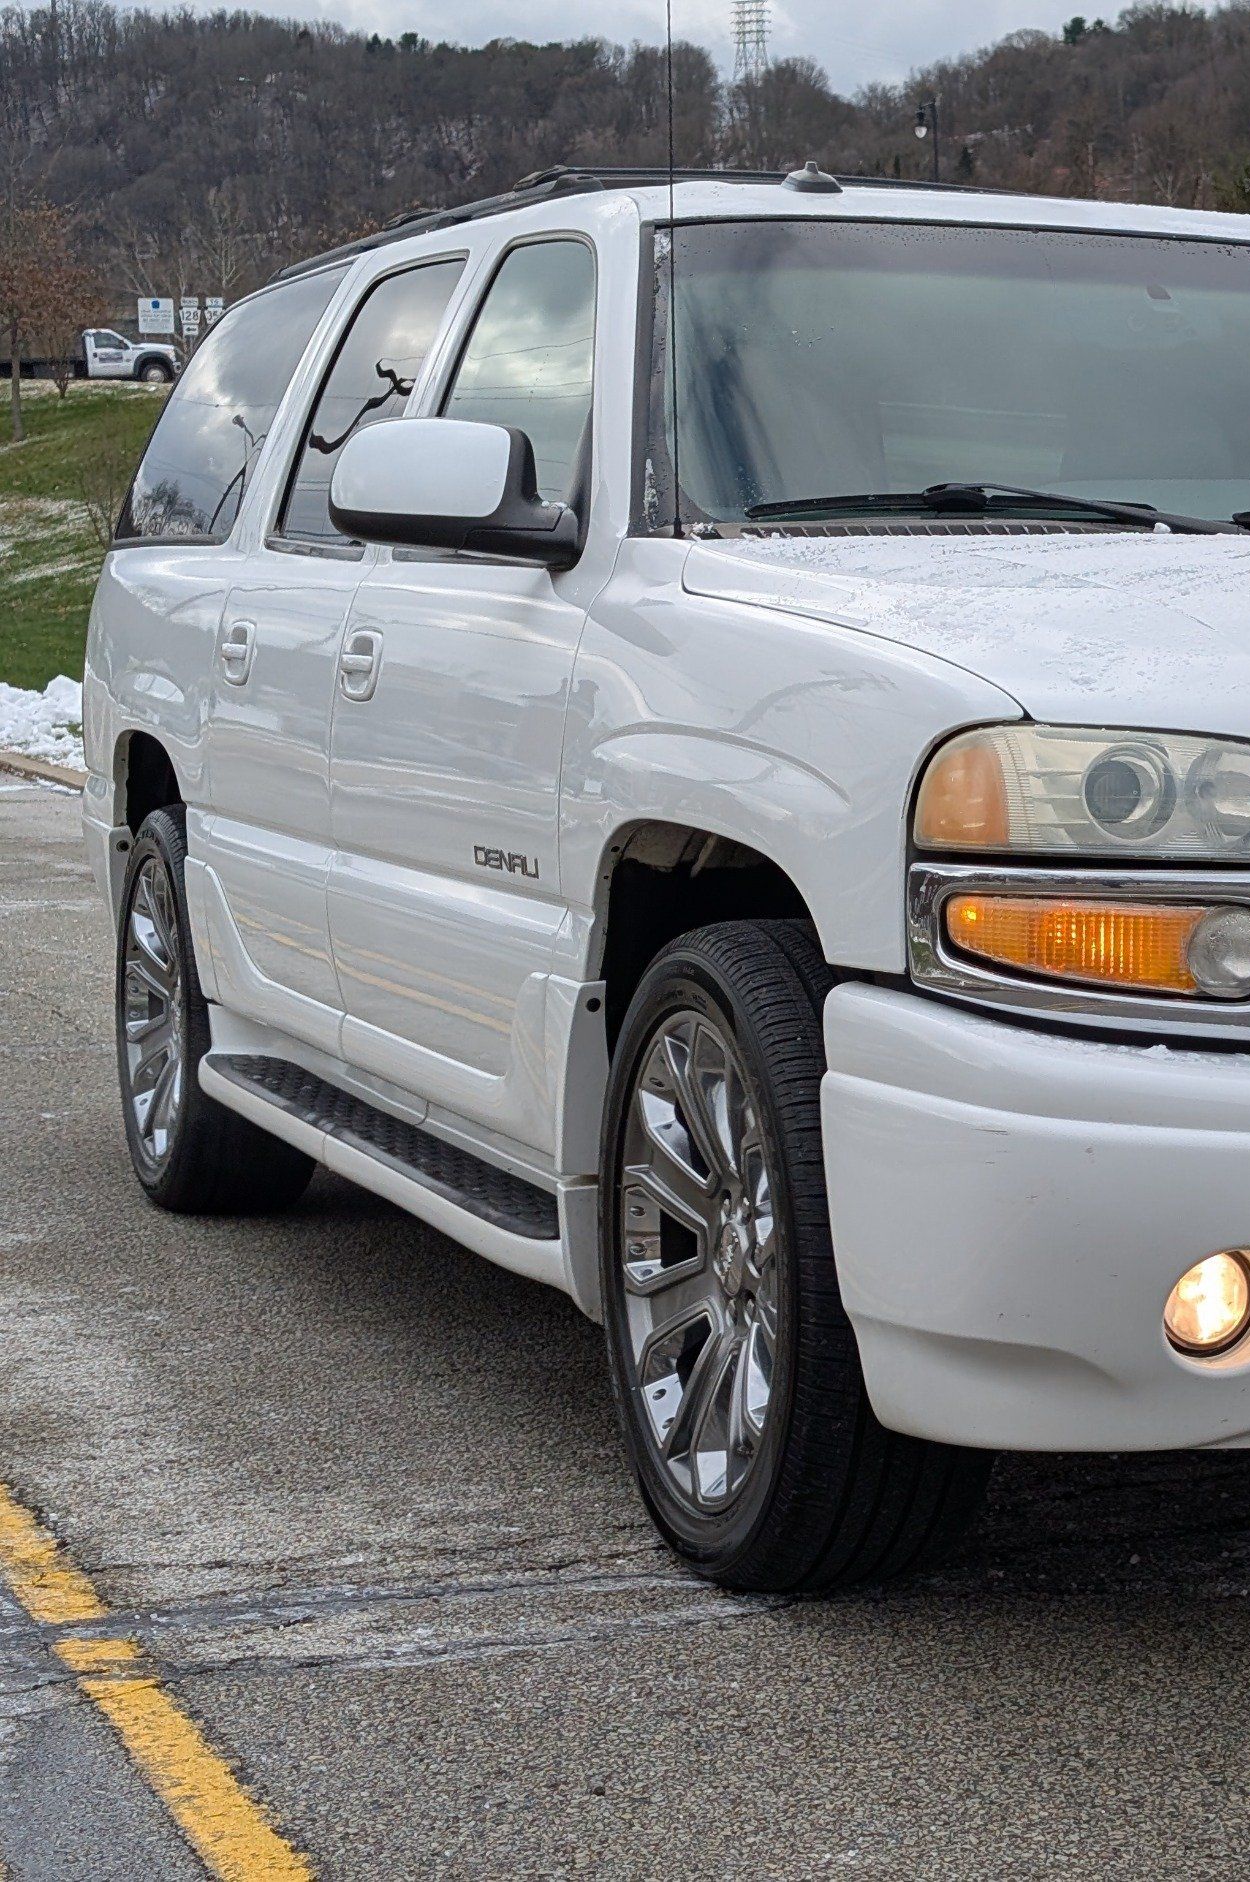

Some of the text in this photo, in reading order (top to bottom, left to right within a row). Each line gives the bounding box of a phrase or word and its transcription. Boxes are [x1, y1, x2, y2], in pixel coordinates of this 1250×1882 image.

[181, 310, 199, 321] 128
[206, 310, 223, 321] 35
[473, 845, 540, 880] DENALI
